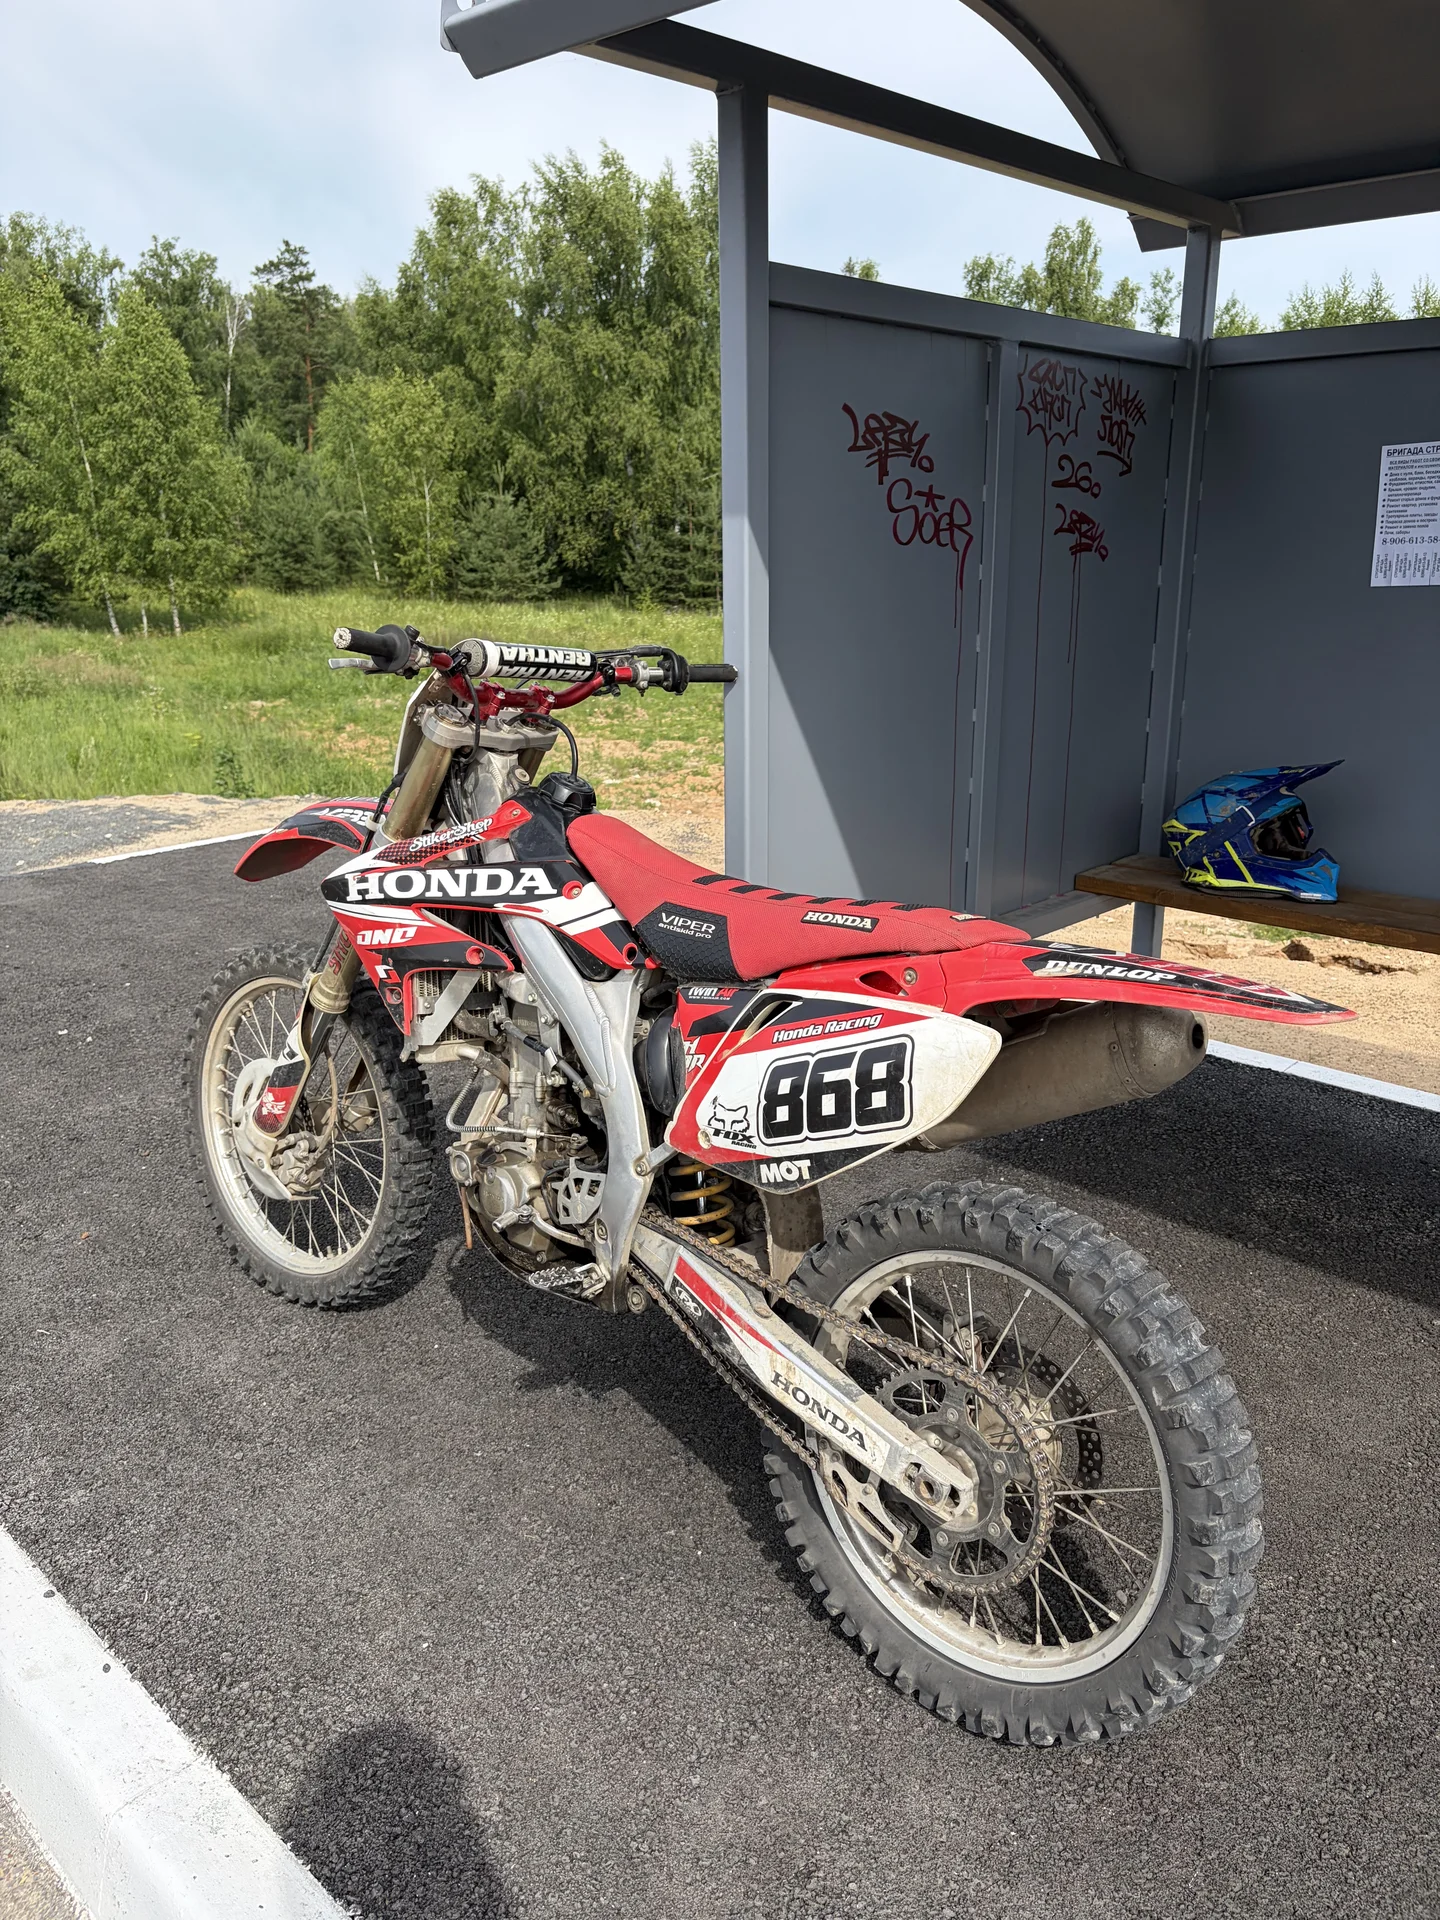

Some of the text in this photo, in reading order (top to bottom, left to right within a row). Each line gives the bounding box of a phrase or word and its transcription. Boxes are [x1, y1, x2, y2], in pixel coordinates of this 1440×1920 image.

[1386, 446, 1424, 457] БРИГАДА
[344, 867, 557, 902] HONDA
[658, 922, 695, 936] antiskid
[661, 912, 716, 934] VIPER
[804, 911, 873, 930] HONDA
[1044, 959, 1176, 982] DUNLOP
[772, 1013, 883, 1044] Honda Racing
[760, 1038, 912, 1145] 868
[712, 1128, 756, 1145] FOX
[731, 1140, 757, 1150] RACING
[760, 1160, 811, 1184] MOT
[771, 1370, 868, 1451] HONDA
